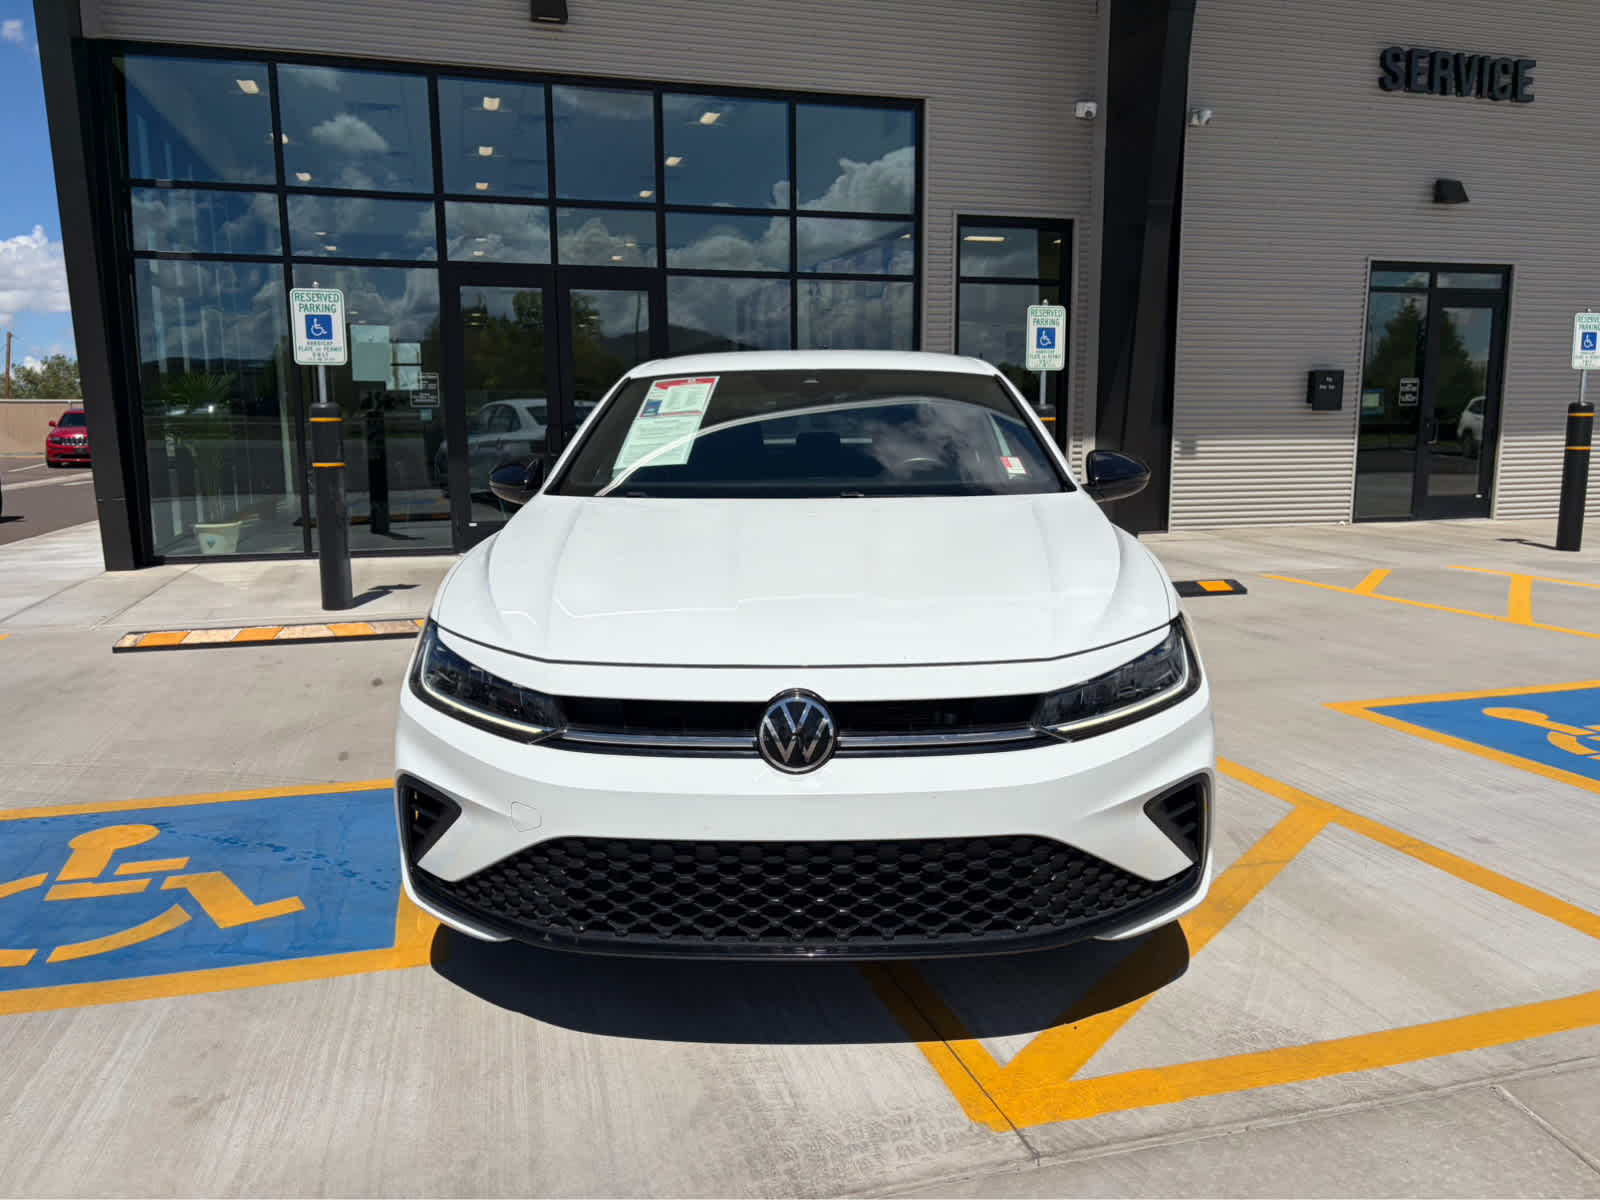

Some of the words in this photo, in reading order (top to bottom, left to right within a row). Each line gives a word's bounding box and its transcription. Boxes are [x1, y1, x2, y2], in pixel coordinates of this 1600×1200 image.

[1379, 47, 1537, 102] SERVICE
[294, 293, 340, 303] RESERVED
[299, 303, 337, 313] PARKING
[1031, 309, 1062, 317] RESERVED
[1033, 317, 1060, 327] PARKING
[761, 697, 833, 767] VW
